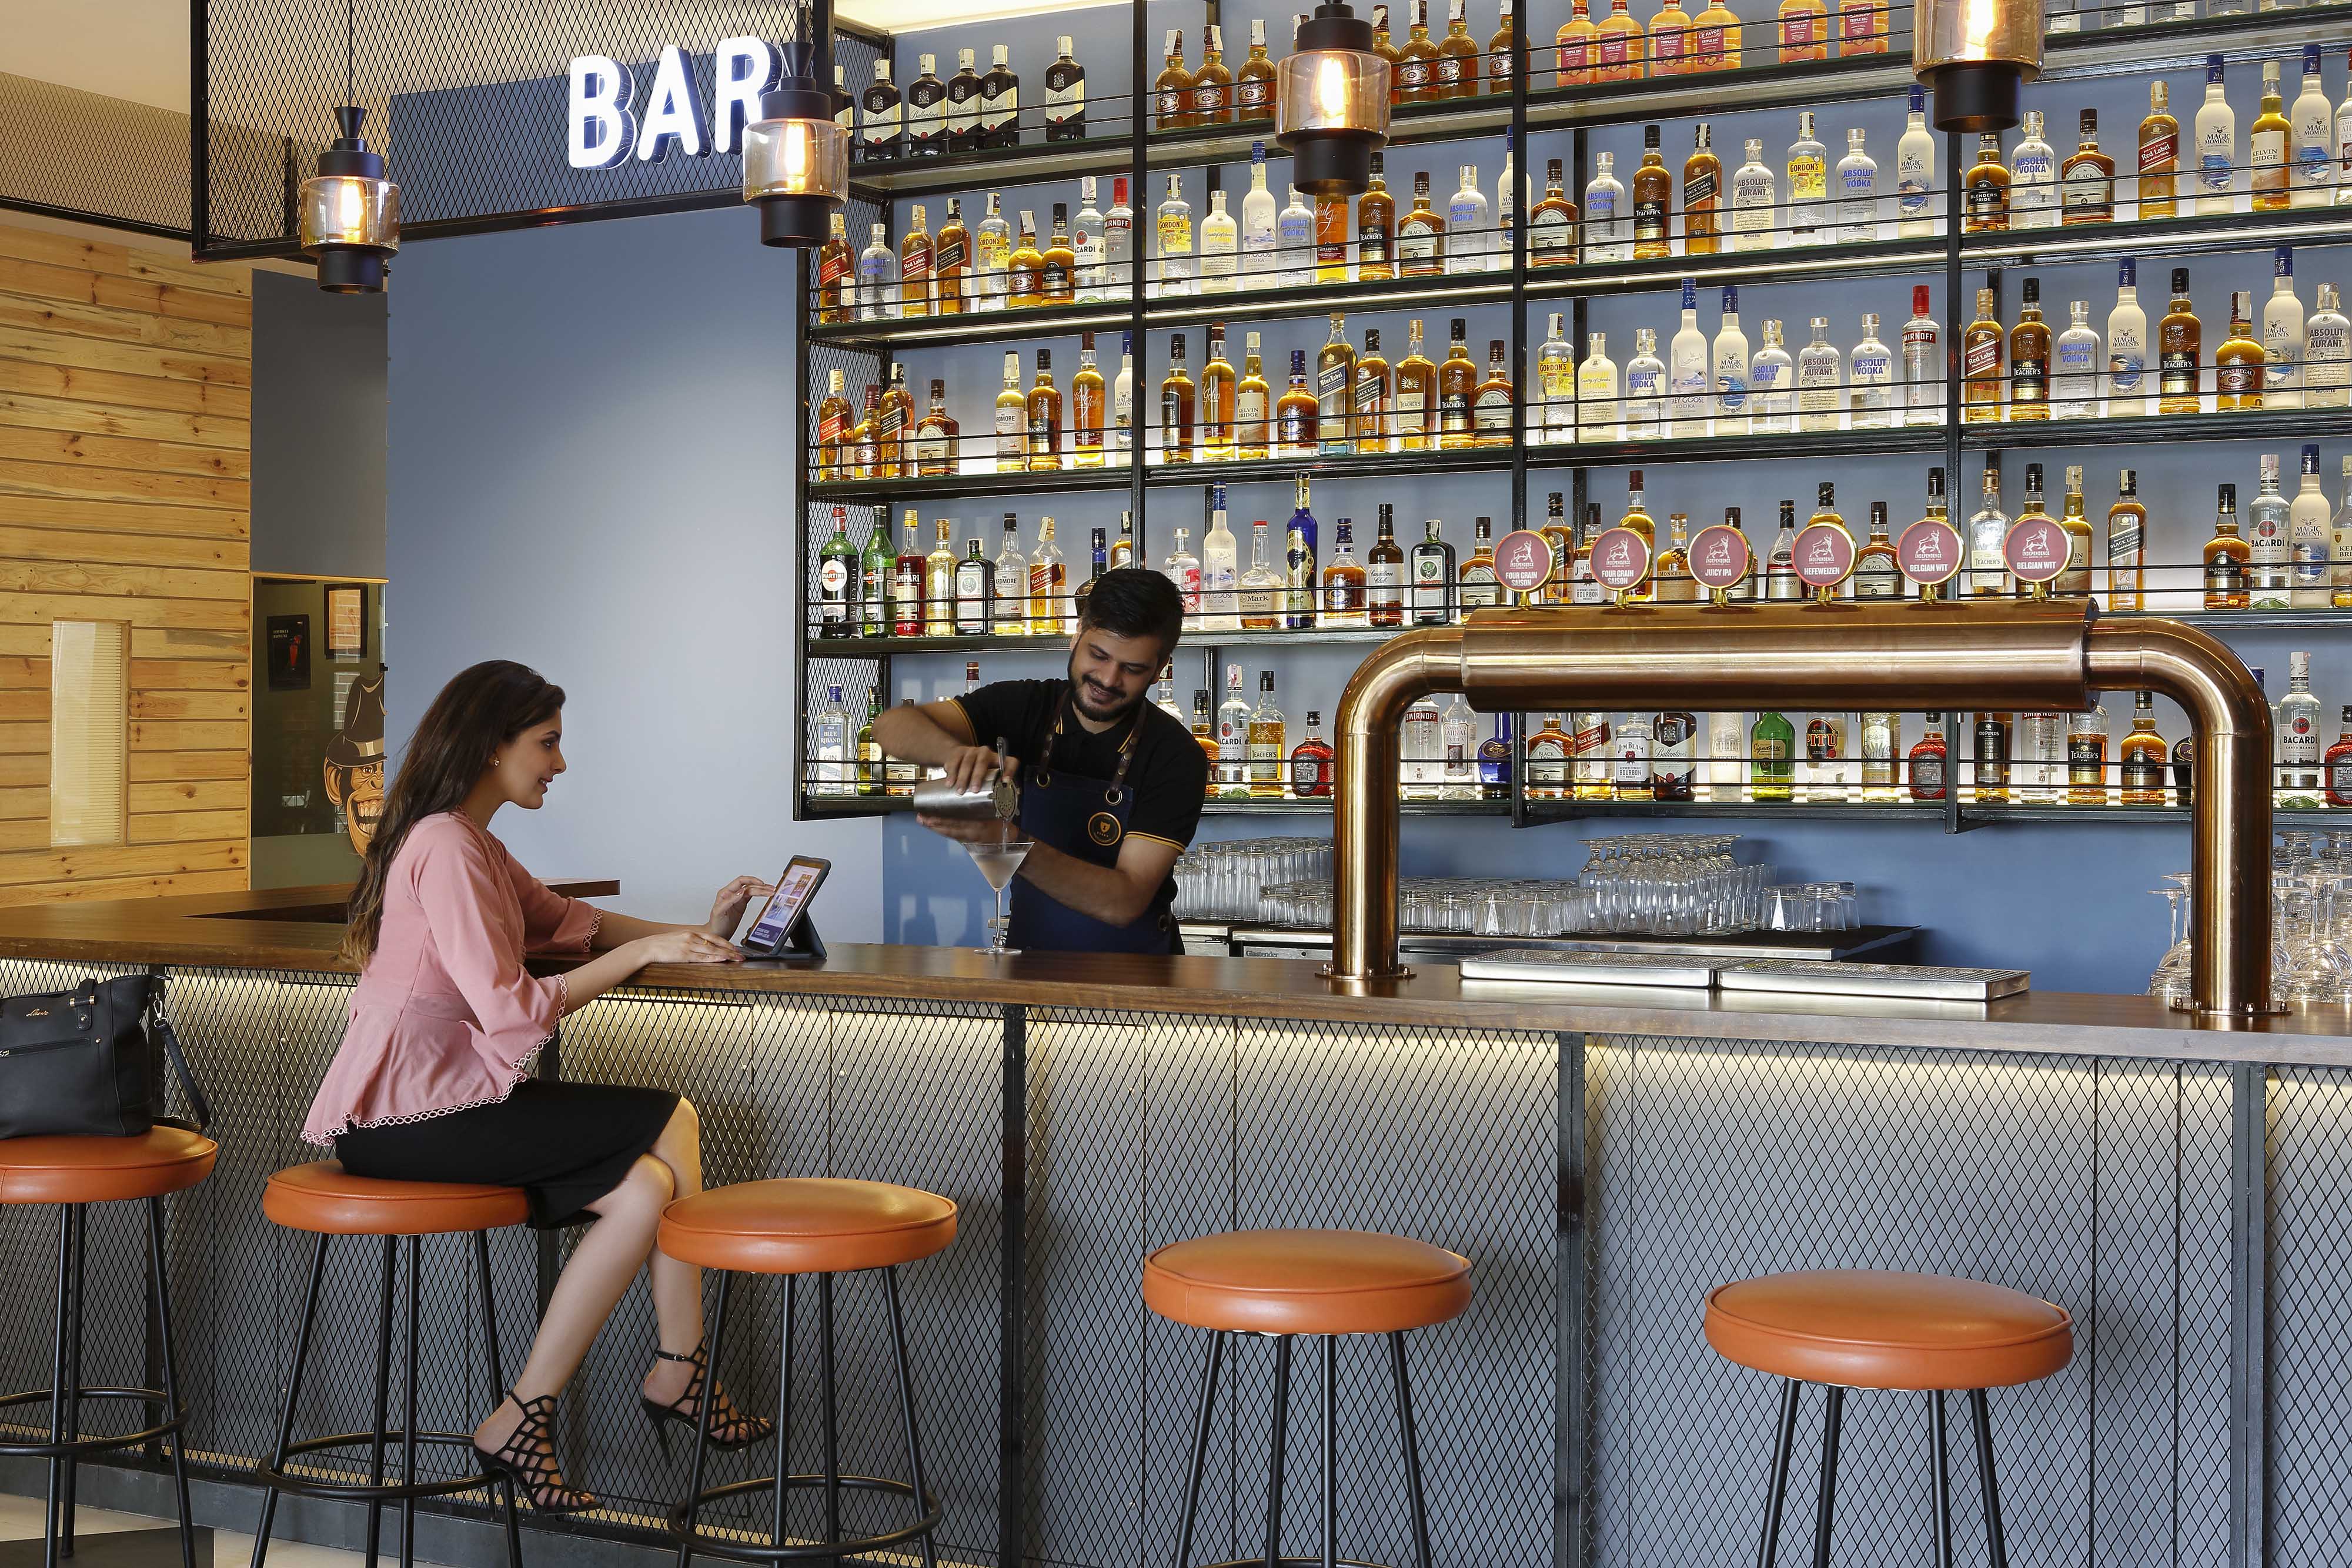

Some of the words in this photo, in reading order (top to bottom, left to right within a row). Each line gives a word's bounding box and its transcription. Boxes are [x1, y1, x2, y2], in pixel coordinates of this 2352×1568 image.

[569, 35, 784, 169] BAR
[2141, 152, 2153, 162] Red
[2153, 145, 2170, 158] Label
[2016, 157, 2049, 166] ABSOLUT
[1790, 163, 1819, 172] GORDON'S
[2019, 165, 2046, 174] VODKA
[1843, 169, 1874, 178] ABSOLUT
[1698, 181, 1711, 190] LABEL
[1737, 179, 1768, 188] ABSOLUT
[1846, 180, 1871, 188] VODKA
[1587, 192, 1616, 200] ABSOLUT
[1738, 188, 1766, 197] KURANT
[1589, 202, 1612, 210] VODKA
[1451, 215, 1473, 223] VODKA
[1159, 220, 1184, 229] GORDON'S
[1360, 232, 1382, 241] TEACHER'S
[948, 251, 960, 261] LABEL
[904, 260, 914, 269] Red
[914, 256, 926, 267] Label
[2310, 328, 2343, 337] ABSOLUT
[2310, 339, 2342, 348] KURANT
[1803, 357, 1835, 366] ABSOLUT
[1968, 356, 1979, 366] Red
[1979, 350, 1996, 362] Label
[1539, 362, 1567, 372] GORDON'S
[1854, 358, 1886, 368] ABSOLUT
[2163, 360, 2193, 369] TEACHER'S
[1805, 367, 1833, 377] KURANT
[1856, 366, 1884, 376] VODKA
[2013, 367, 2042, 376] TEACHER'S
[2219, 369, 2235, 377] CHIVAS
[2236, 367, 2253, 376] REGAL
[1628, 372, 1657, 382] ABSOLUT
[1753, 373, 1776, 382] VODKA
[1367, 384, 1381, 394] LABEL
[1400, 400, 1421, 408] TEACHER'S
[1442, 401, 1465, 409] TEACHER'S
[2110, 539, 2126, 550] BLACK
[2126, 534, 2142, 544] LABEL
[2251, 537, 2285, 548] BACARDÍ
[1575, 564, 1586, 576] JIM
[1935, 563, 1948, 571] WIT
[2017, 561, 2043, 570] BELGIAN
[2043, 561, 2056, 570] WIT
[1505, 571, 1520, 580] FOUR
[1520, 571, 1538, 580] GRAIN
[1602, 569, 1616, 578] FOUR
[1616, 569, 1634, 577] GRAIN
[1804, 567, 1840, 576] HEFEWEIZEN
[1031, 576, 1041, 586] Red
[1041, 572, 1052, 583] Label
[1512, 579, 1532, 587] SAISON
[1608, 577, 1628, 586] SAISON
[1406, 712, 1436, 721] SMIRNOFF
[820, 737, 841, 745] RIBAND
[1578, 736, 1587, 746] Red
[1587, 732, 1601, 743] Label
[2284, 734, 2318, 744] BACARDÍ
[1618, 744, 1628, 754] JIM
[1628, 741, 1645, 754] BEAM
[1251, 751, 1277, 759] TEACHER'S
[2071, 751, 2099, 760] TEACHER'S
